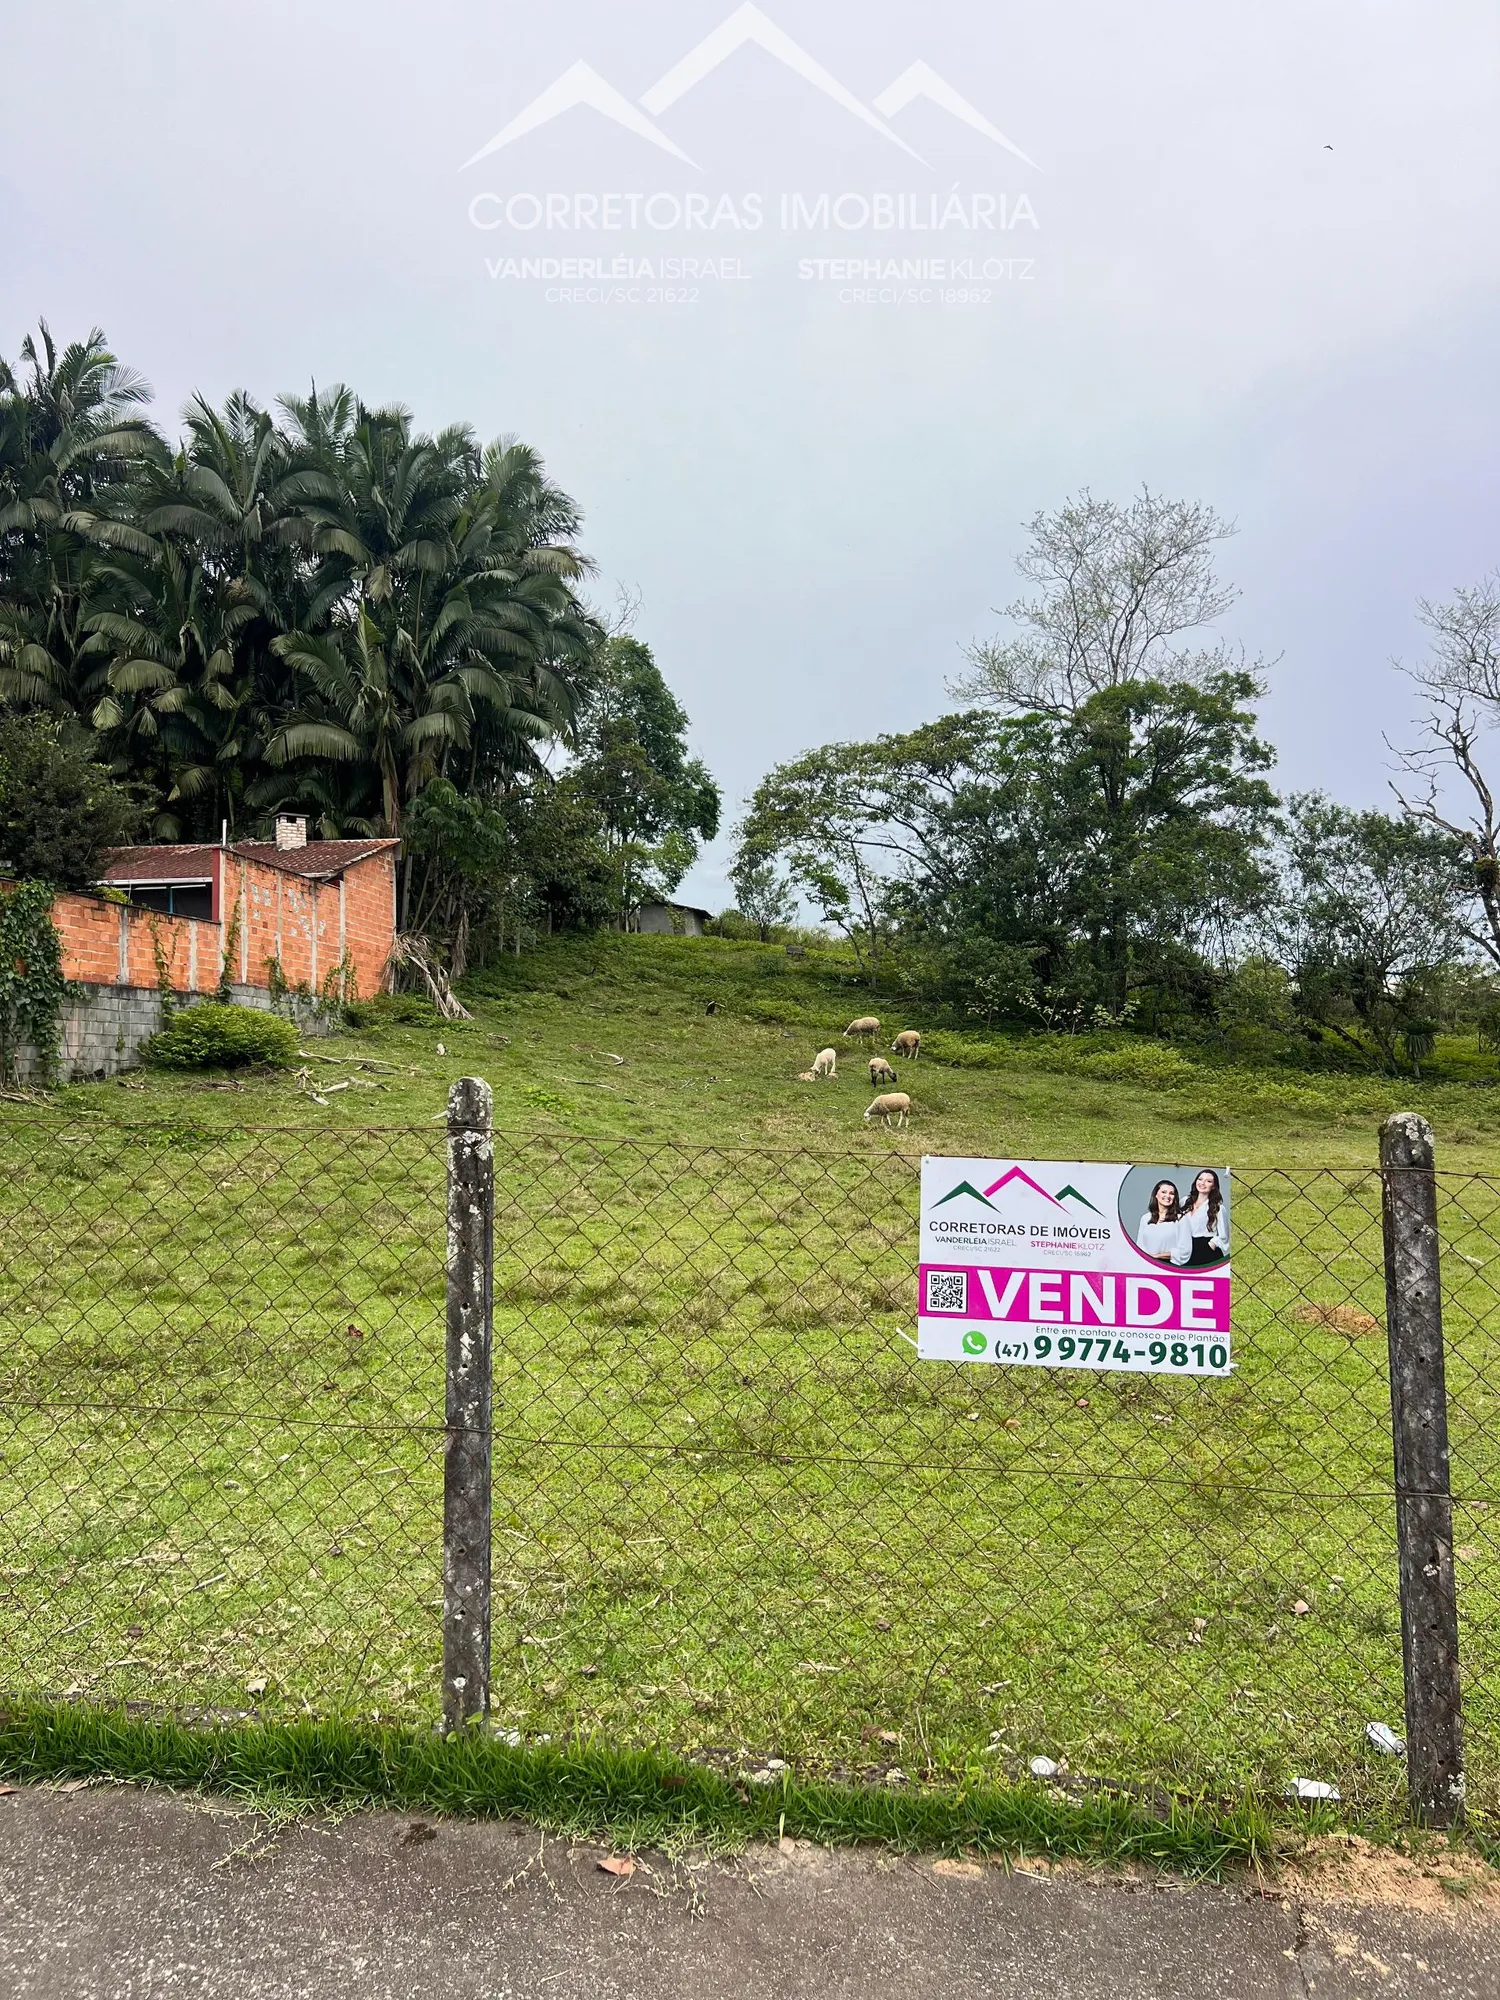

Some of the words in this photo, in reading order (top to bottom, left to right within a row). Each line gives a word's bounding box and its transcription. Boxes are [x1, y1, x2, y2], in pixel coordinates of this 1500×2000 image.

[929, 1221, 1026, 1236] CORRETORAS
[1030, 1226, 1049, 1237] DE
[1053, 1225, 1111, 1240] IMÓVEIS
[987, 1238, 1017, 1247] ISRAEL
[1030, 1240, 1077, 1250] STEPHANIE
[1077, 1242, 1105, 1251] KLOTZ
[977, 1269, 1217, 1329] VENDE
[1035, 1325, 1059, 1335] Entre
[1079, 1328, 1117, 1337] contato
[1119, 1331, 1161, 1340] conosco
[1163, 1333, 1186, 1342] pelo
[995, 1340, 1029, 1360] (47)
